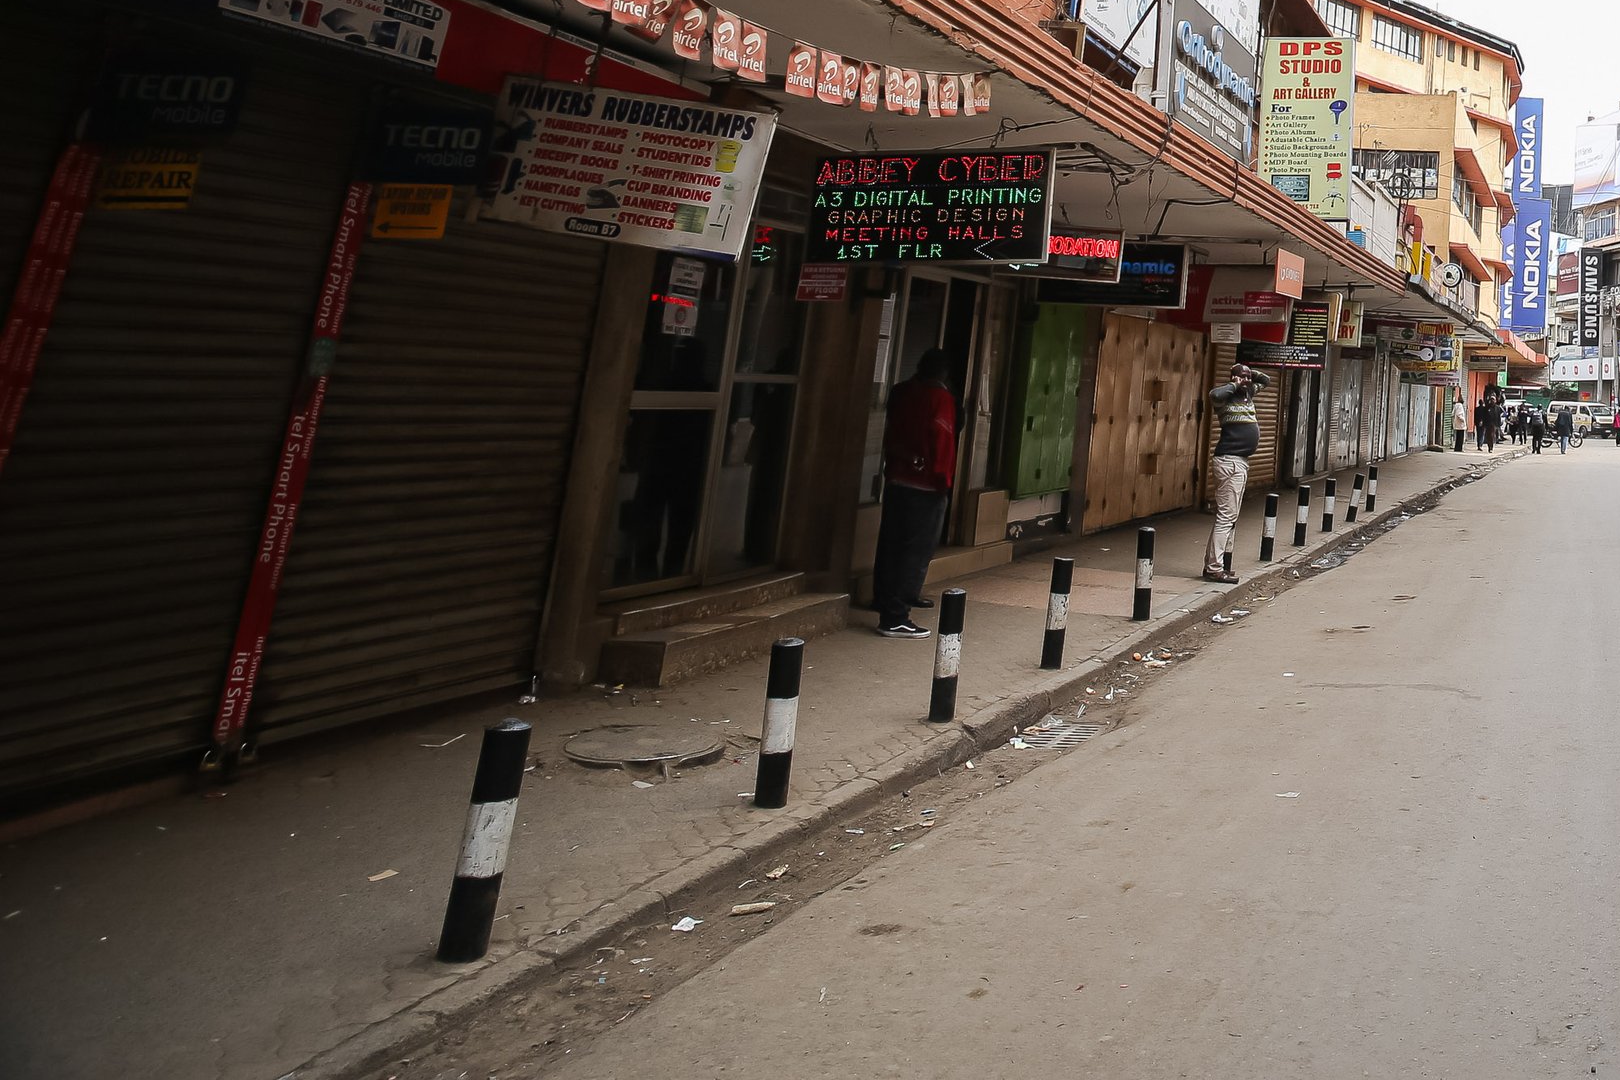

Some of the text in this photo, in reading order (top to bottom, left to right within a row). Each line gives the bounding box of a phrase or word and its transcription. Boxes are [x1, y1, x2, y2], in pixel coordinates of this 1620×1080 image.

[673, 30, 700, 50] airtel
[1279, 41, 1343, 56] DPS
[713, 44, 739, 62] airtel
[1279, 59, 1342, 75] STUDIO
[114, 72, 236, 104] TECNO
[788, 72, 813, 88] airtel
[818, 82, 841, 96] airtel
[1302, 77, 1311, 88] &
[861, 92, 877, 104] airtel
[903, 97, 920, 108] airtel
[974, 97, 990, 107] airtel
[1273, 88, 1337, 100] ART GALLERY
[508, 82, 757, 141] WINVERS RUBBERSTAMPS
[941, 100, 957, 109] airtel
[1270, 104, 1293, 113] For
[544, 117, 628, 139] RUBBERSTAMPS
[1281, 121, 1308, 130] Gallery
[383, 124, 482, 150] TECNO
[540, 132, 623, 155] COMPANY SEALS
[642, 130, 715, 152] PHOTOCOPY
[414, 149, 477, 170] mobile
[534, 148, 618, 170] RECEIPT BOOKS
[636, 146, 692, 166] STUDENT
[1519, 114, 1537, 193] NOKIA
[529, 163, 604, 186] DOORPLAQUES
[632, 163, 722, 188] T-SHIRT PRINTING
[816, 154, 1044, 185] ABBEY CYBER
[523, 180, 581, 197] NAMETAGS
[626, 179, 712, 202] CUP BRANDING
[853, 189, 934, 208] DIGITAL
[947, 187, 1042, 205] PRINTING
[519, 195, 586, 215] KEY CUTTING
[622, 195, 677, 214] BANNERS
[618, 211, 675, 231] STICKERS
[827, 207, 1025, 225] GRAPHIC DESIGN
[568, 219, 617, 236] Room B7
[825, 224, 1024, 242] MEETING HALLS
[836, 243, 942, 260] 1ST FLR
[318, 215, 355, 329] Smart Phone
[1523, 219, 1542, 309] NOKIA
[1212, 295, 1245, 305] active
[1585, 255, 1599, 339] SAMSUNG
[279, 442, 300, 499] Smart
[260, 503, 287, 563] Phone
[231, 651, 251, 683] itel
